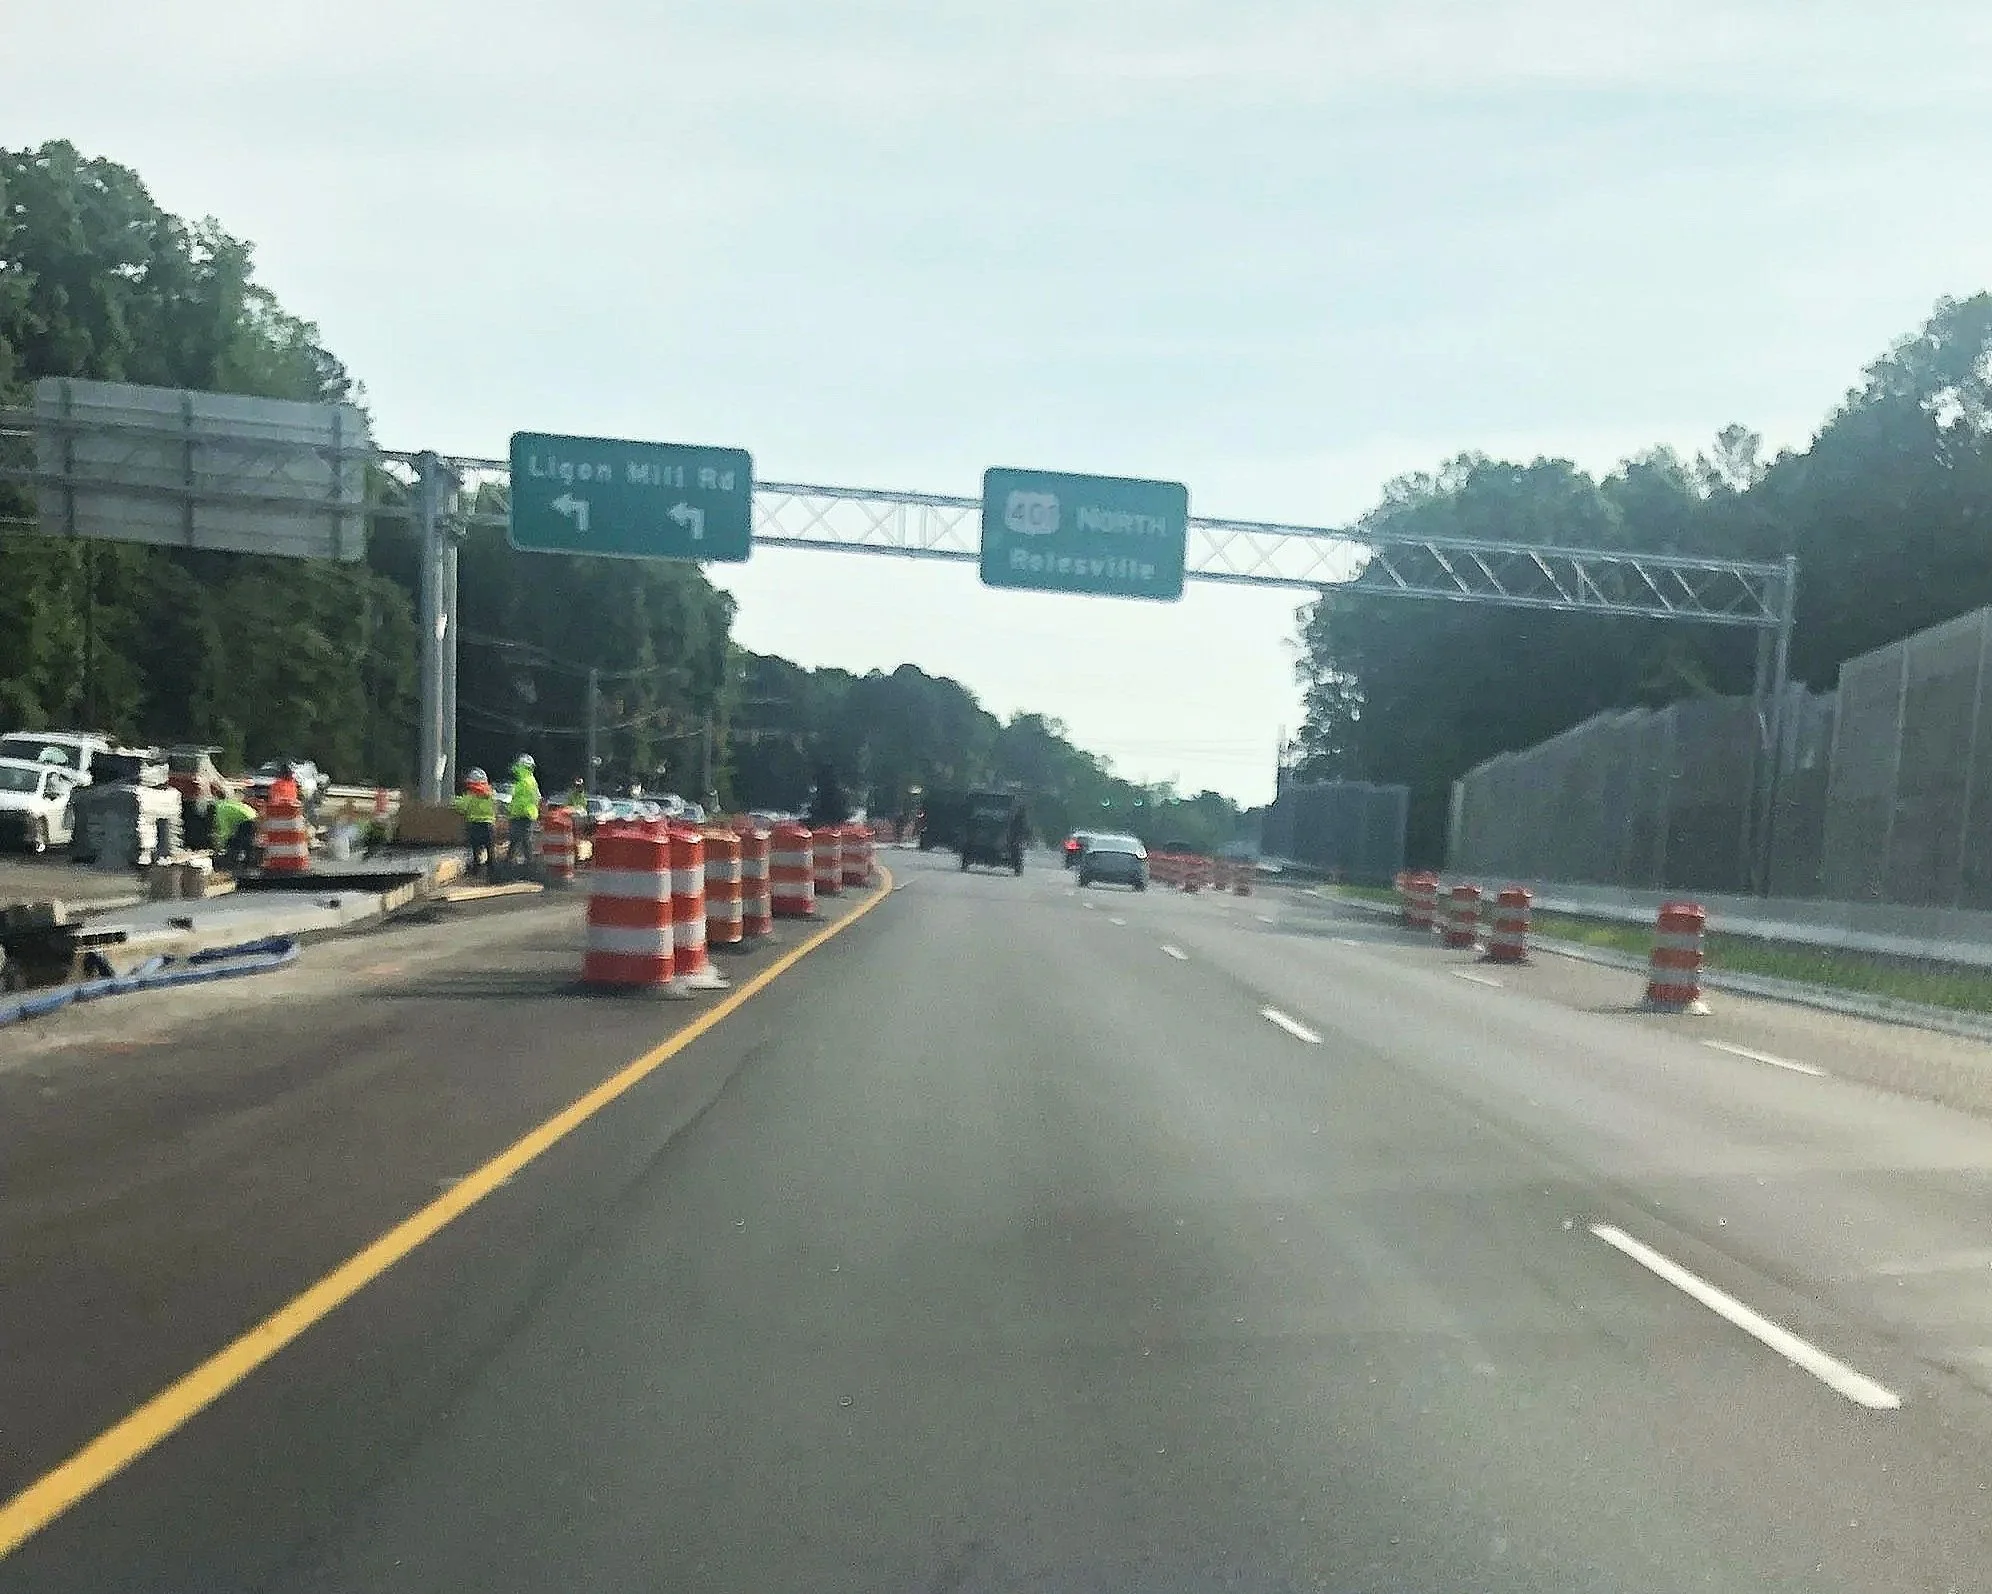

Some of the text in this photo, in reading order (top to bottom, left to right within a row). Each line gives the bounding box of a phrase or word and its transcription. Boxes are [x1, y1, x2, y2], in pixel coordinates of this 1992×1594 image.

[528, 455, 736, 491] Ligon Mill Rd
[1076, 506, 1168, 536] NORTH
